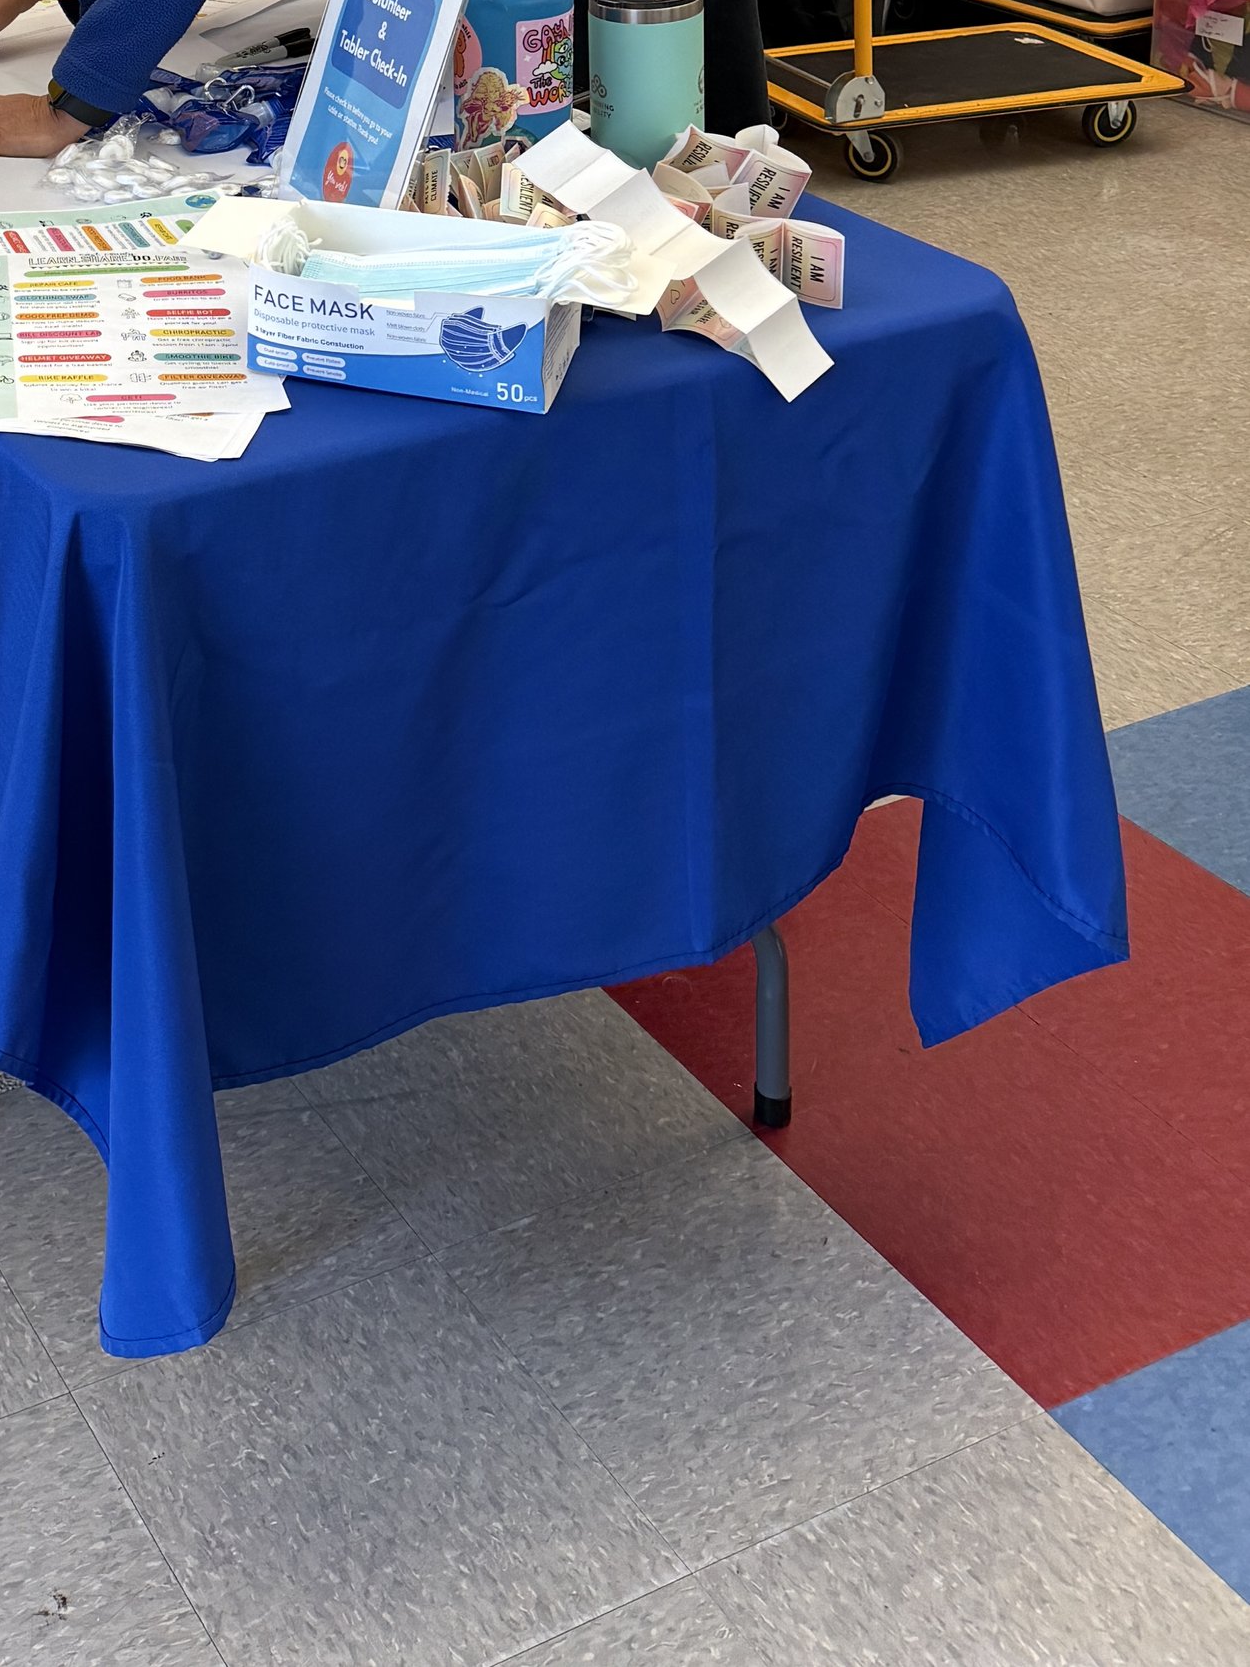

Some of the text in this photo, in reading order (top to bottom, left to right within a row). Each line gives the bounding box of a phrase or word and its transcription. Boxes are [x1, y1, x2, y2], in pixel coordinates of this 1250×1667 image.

[378, 21, 387, 40] &
[339, 30, 408, 87] Tabler Check-In
[530, 76, 552, 89] The
[325, 170, 336, 186] You
[430, 170, 439, 202] CLIMATE
[750, 167, 776, 211] RESILIEN
[518, 174, 534, 216] ESILIENT
[767, 193, 786, 210] AM
[790, 235, 803, 290] RESILIENT
[809, 265, 825, 284] AM
[254, 284, 375, 321] FACE MASK
[254, 308, 375, 337] Disposable protective mask
[260, 326, 276, 338] layer
[277, 331, 295, 341] Fiber
[296, 334, 319, 345] Fabric
[320, 339, 365, 351] Constuction
[451, 386, 489, 397] Non-Medical
[496, 382, 524, 402] 50
